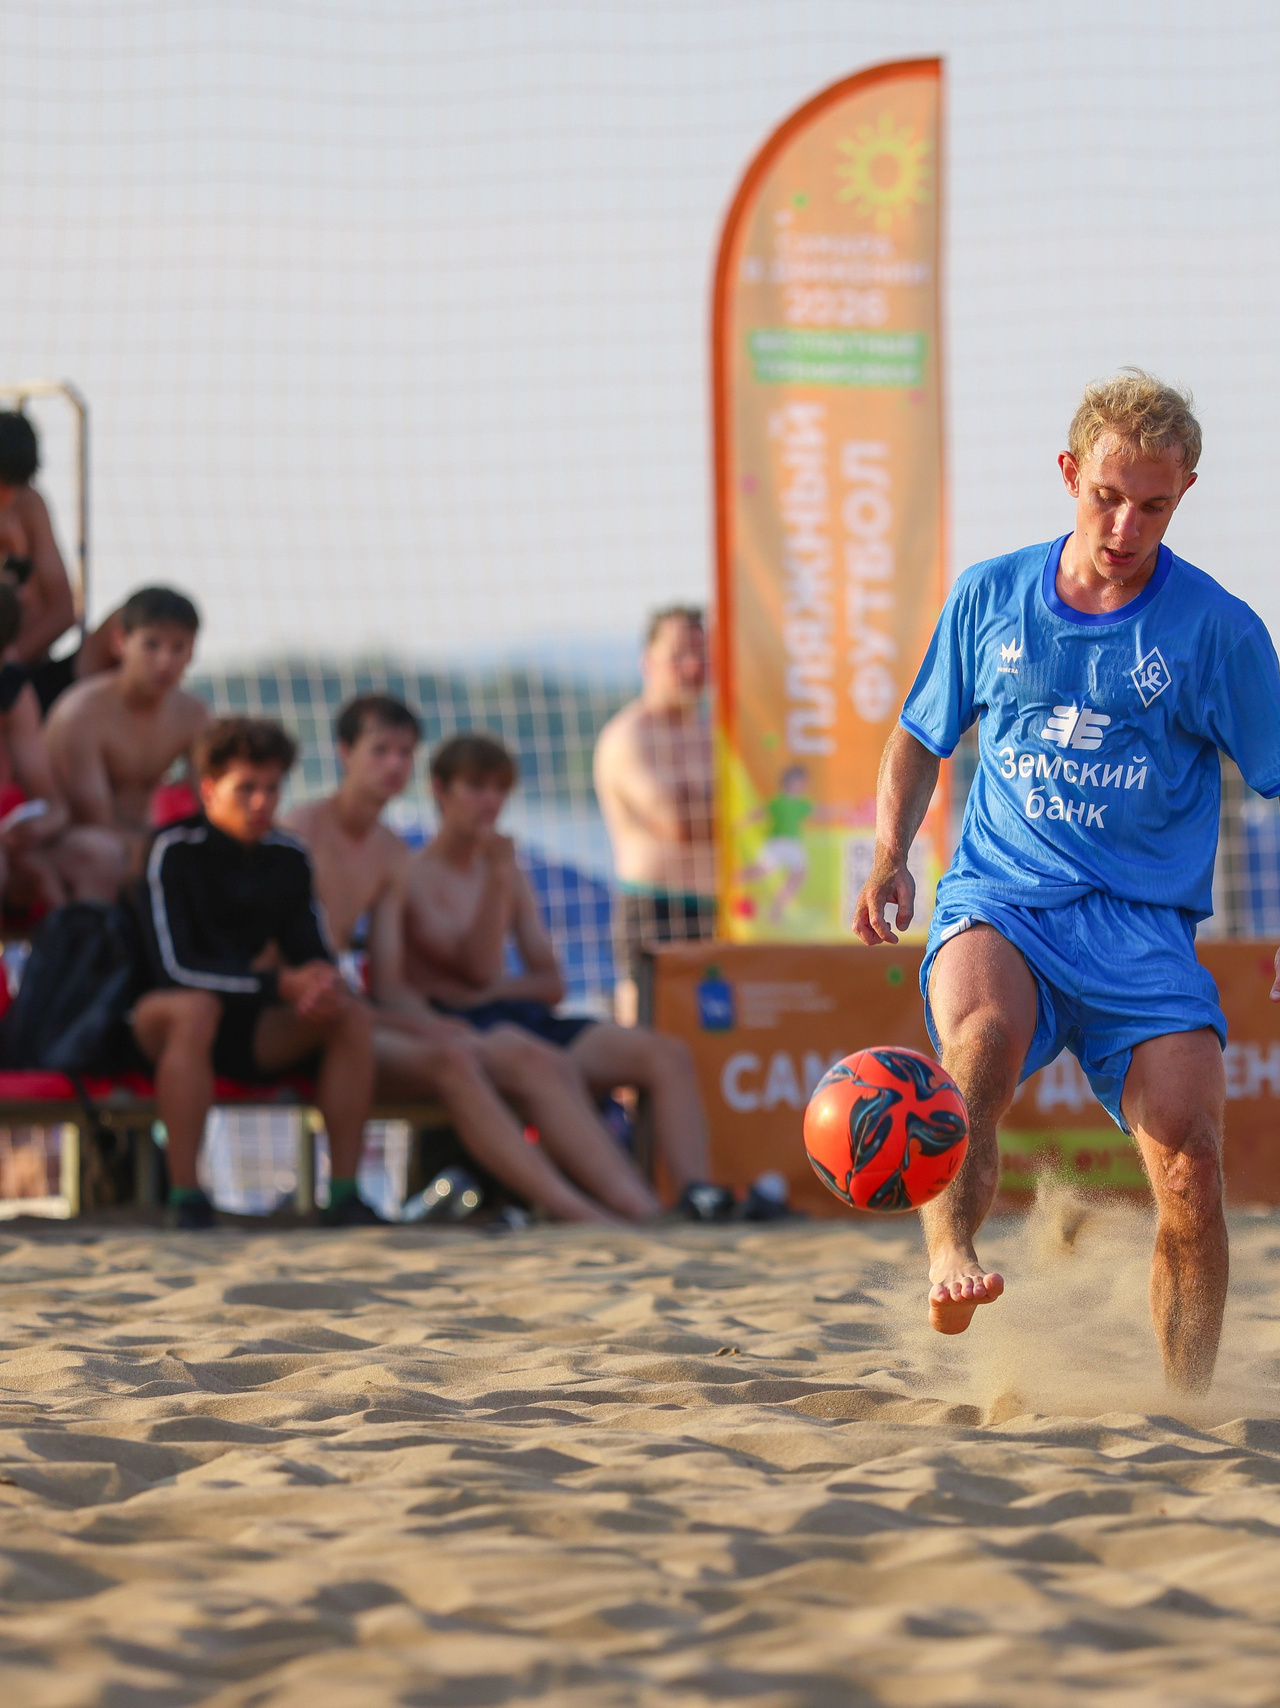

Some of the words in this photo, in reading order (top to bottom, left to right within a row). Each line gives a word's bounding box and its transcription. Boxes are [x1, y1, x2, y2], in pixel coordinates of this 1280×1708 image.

[769, 402, 836, 756] ПЛЯЖНЫЙ
[840, 438, 897, 723] ФУТБОЛ
[999, 746, 1149, 790] Земский
[1025, 785, 1109, 829] банк
